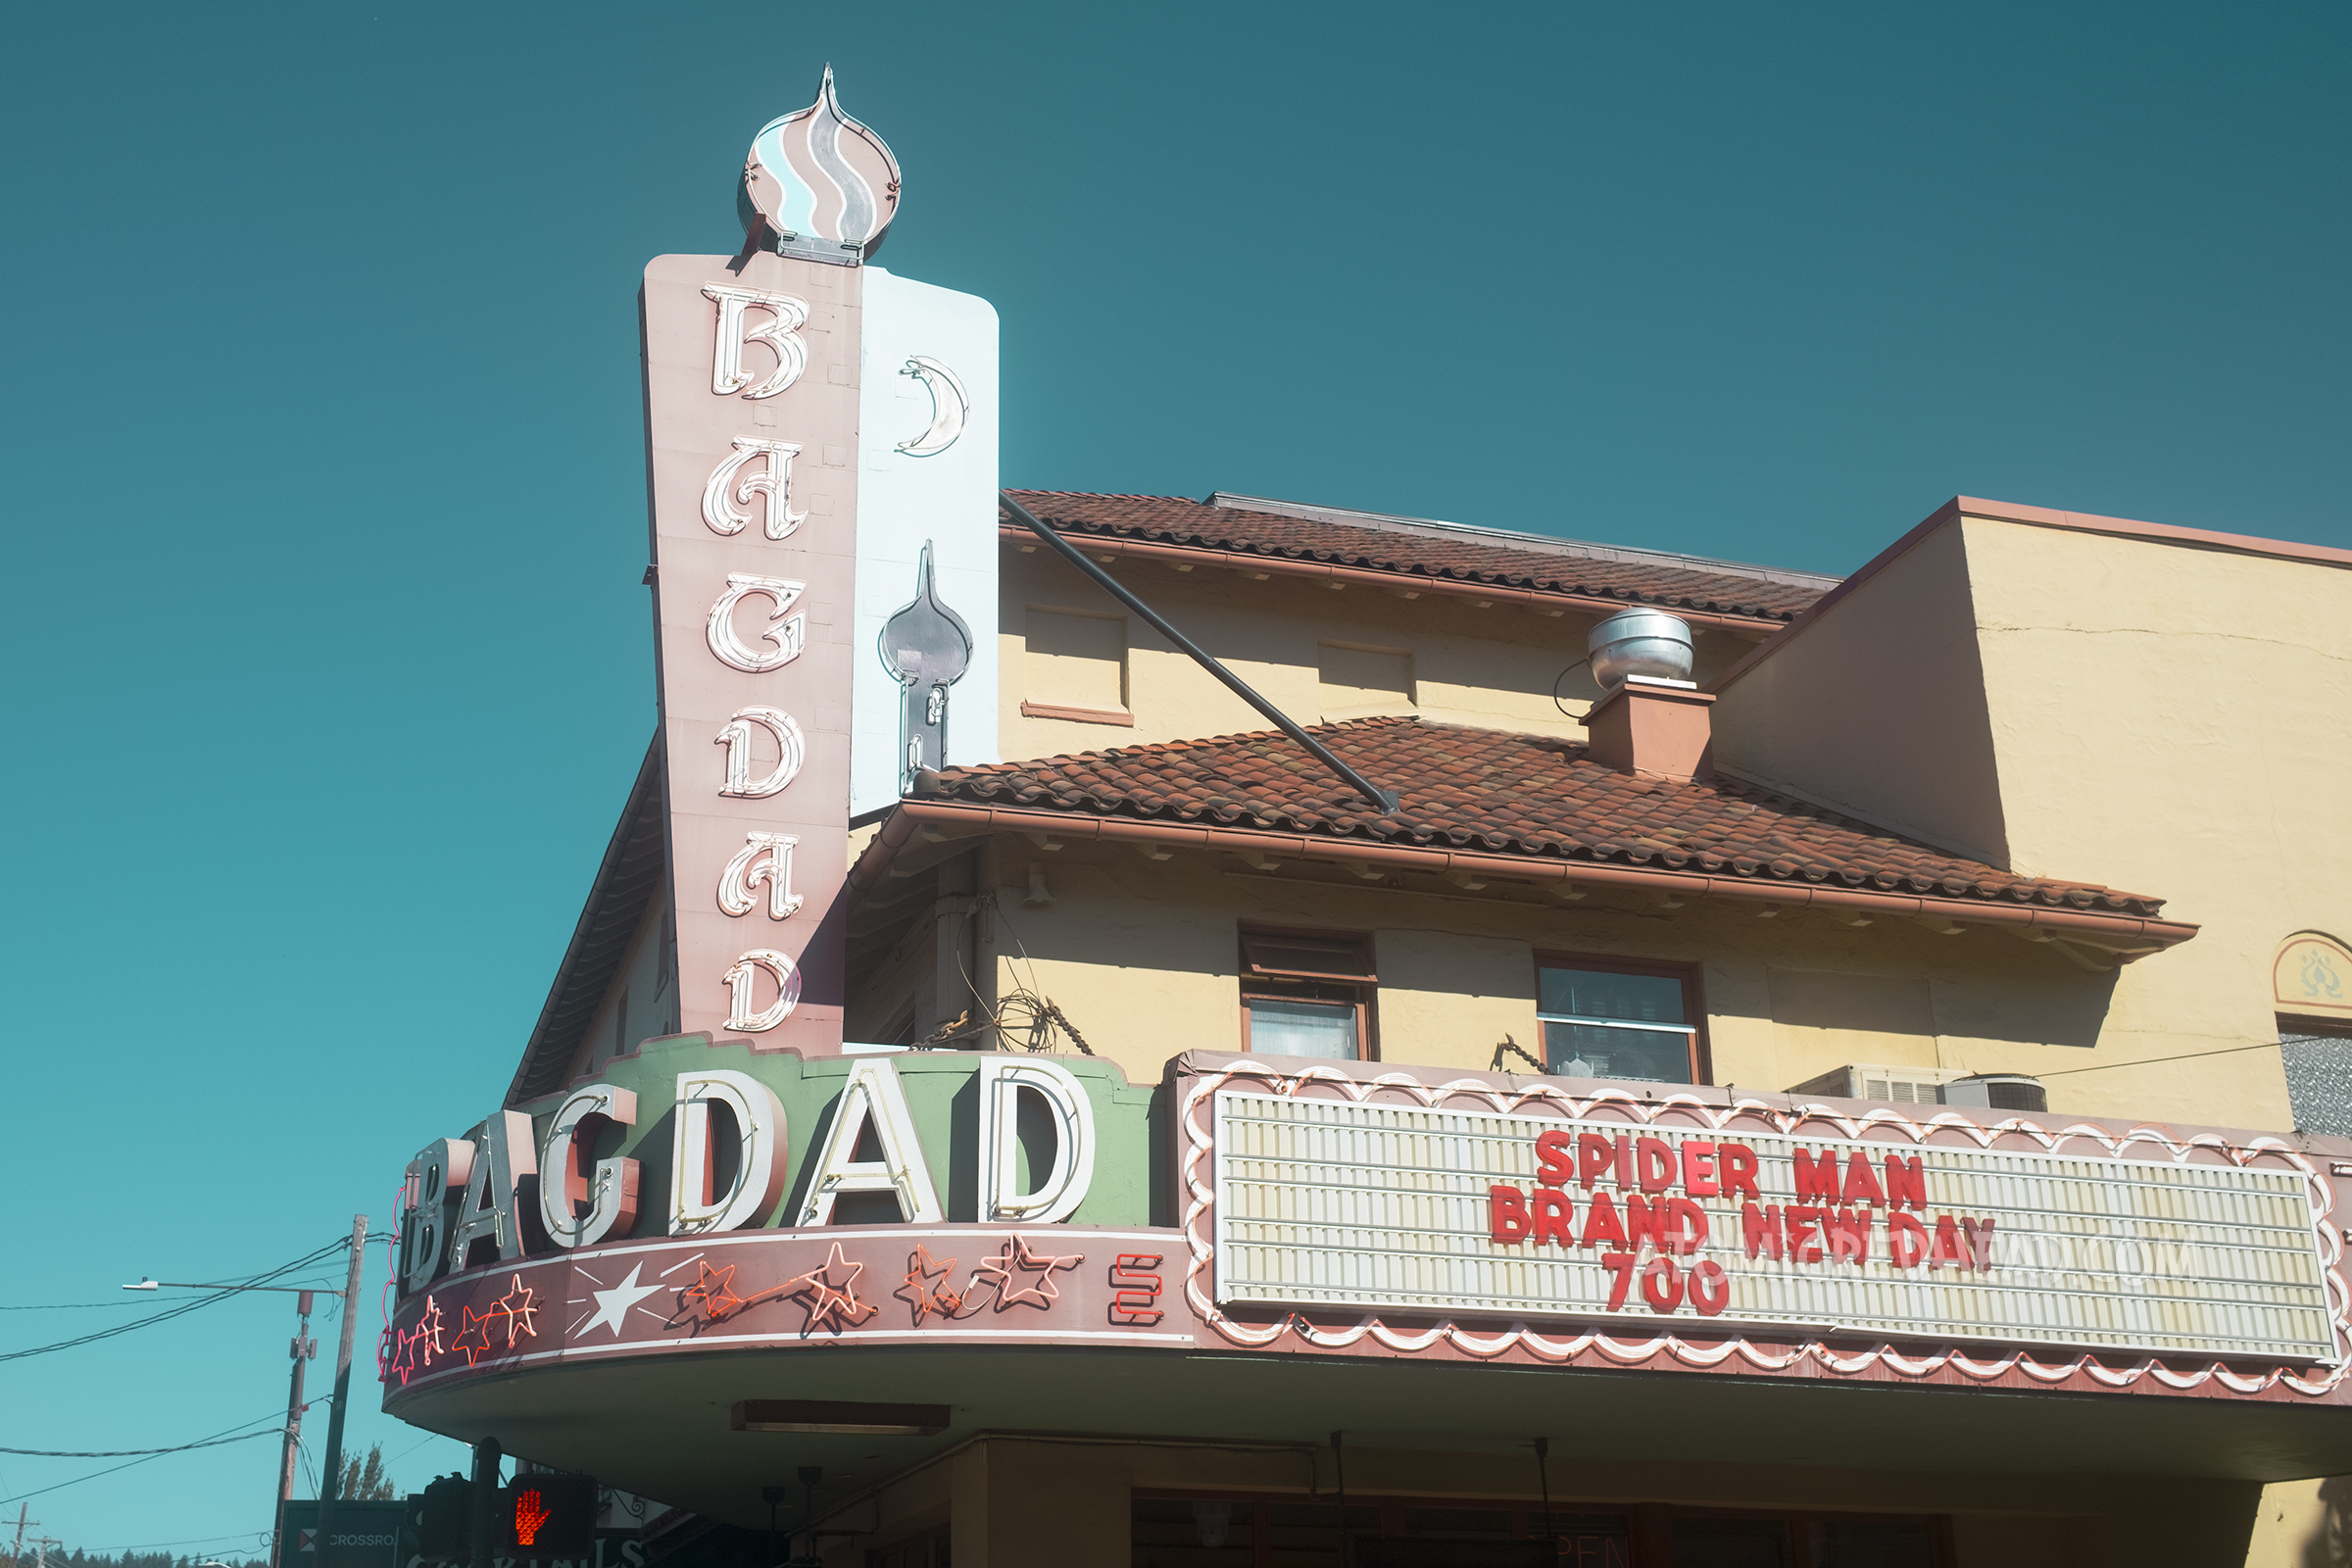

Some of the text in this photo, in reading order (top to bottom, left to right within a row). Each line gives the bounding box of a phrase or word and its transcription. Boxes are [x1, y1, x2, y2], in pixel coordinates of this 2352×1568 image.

[700, 281, 810, 1033] BAGDAD
[397, 1056, 1097, 1299] BAGDAD
[1536, 1130, 1928, 1210] SPIDER MAN
[1492, 1186, 1997, 1273] BRAND NEW DAY
[1601, 1252, 1731, 1315] 700
[329, 1534, 397, 1546] CROSSRO
